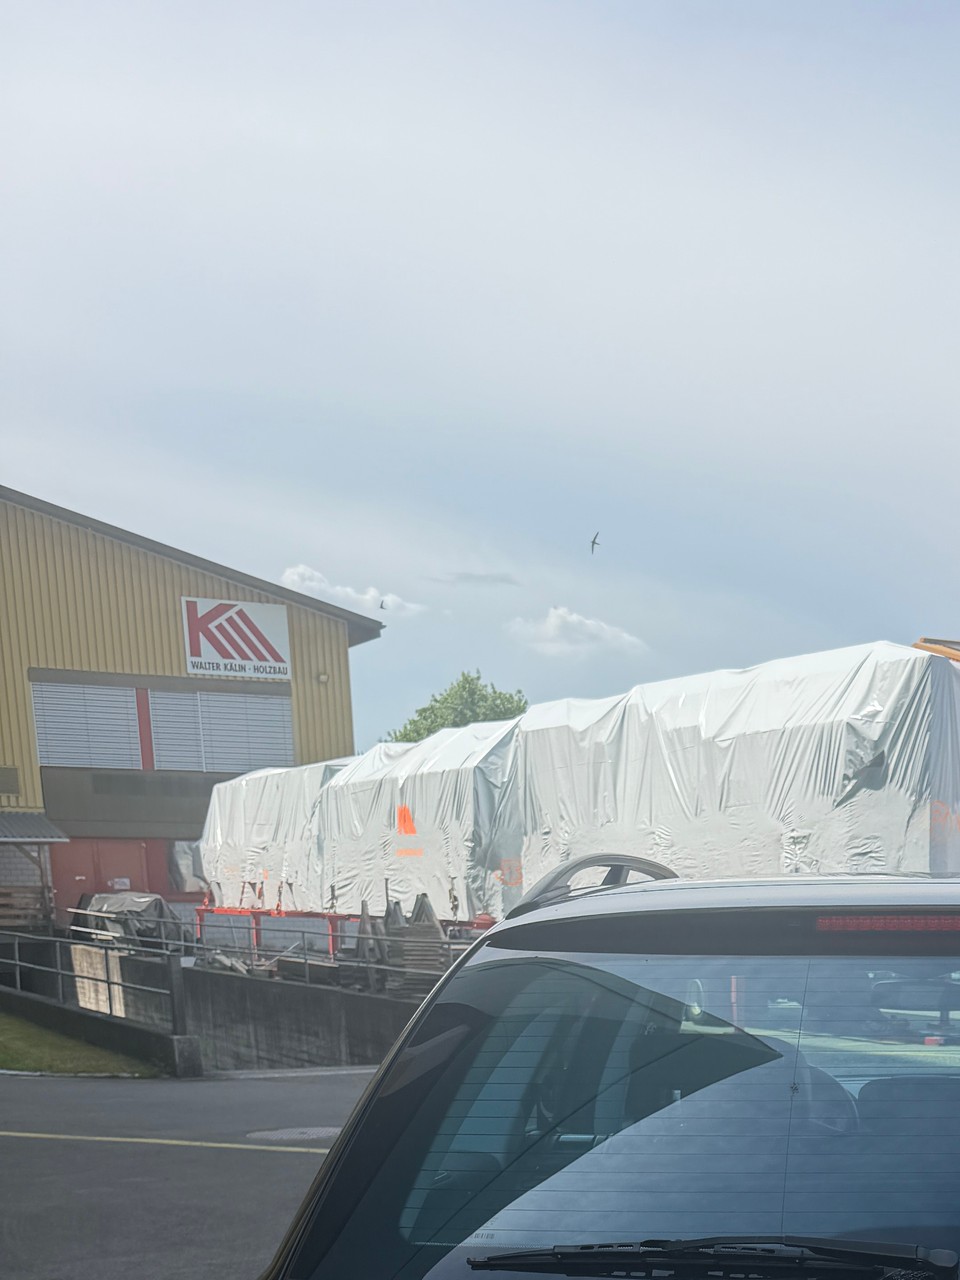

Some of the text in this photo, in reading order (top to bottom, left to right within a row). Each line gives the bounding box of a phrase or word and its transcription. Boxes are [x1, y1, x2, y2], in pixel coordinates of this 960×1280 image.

[190, 660, 222, 672] WALTER
[223, 661, 247, 674] KÄLIN
[253, 664, 288, 676] HOLZBAU
